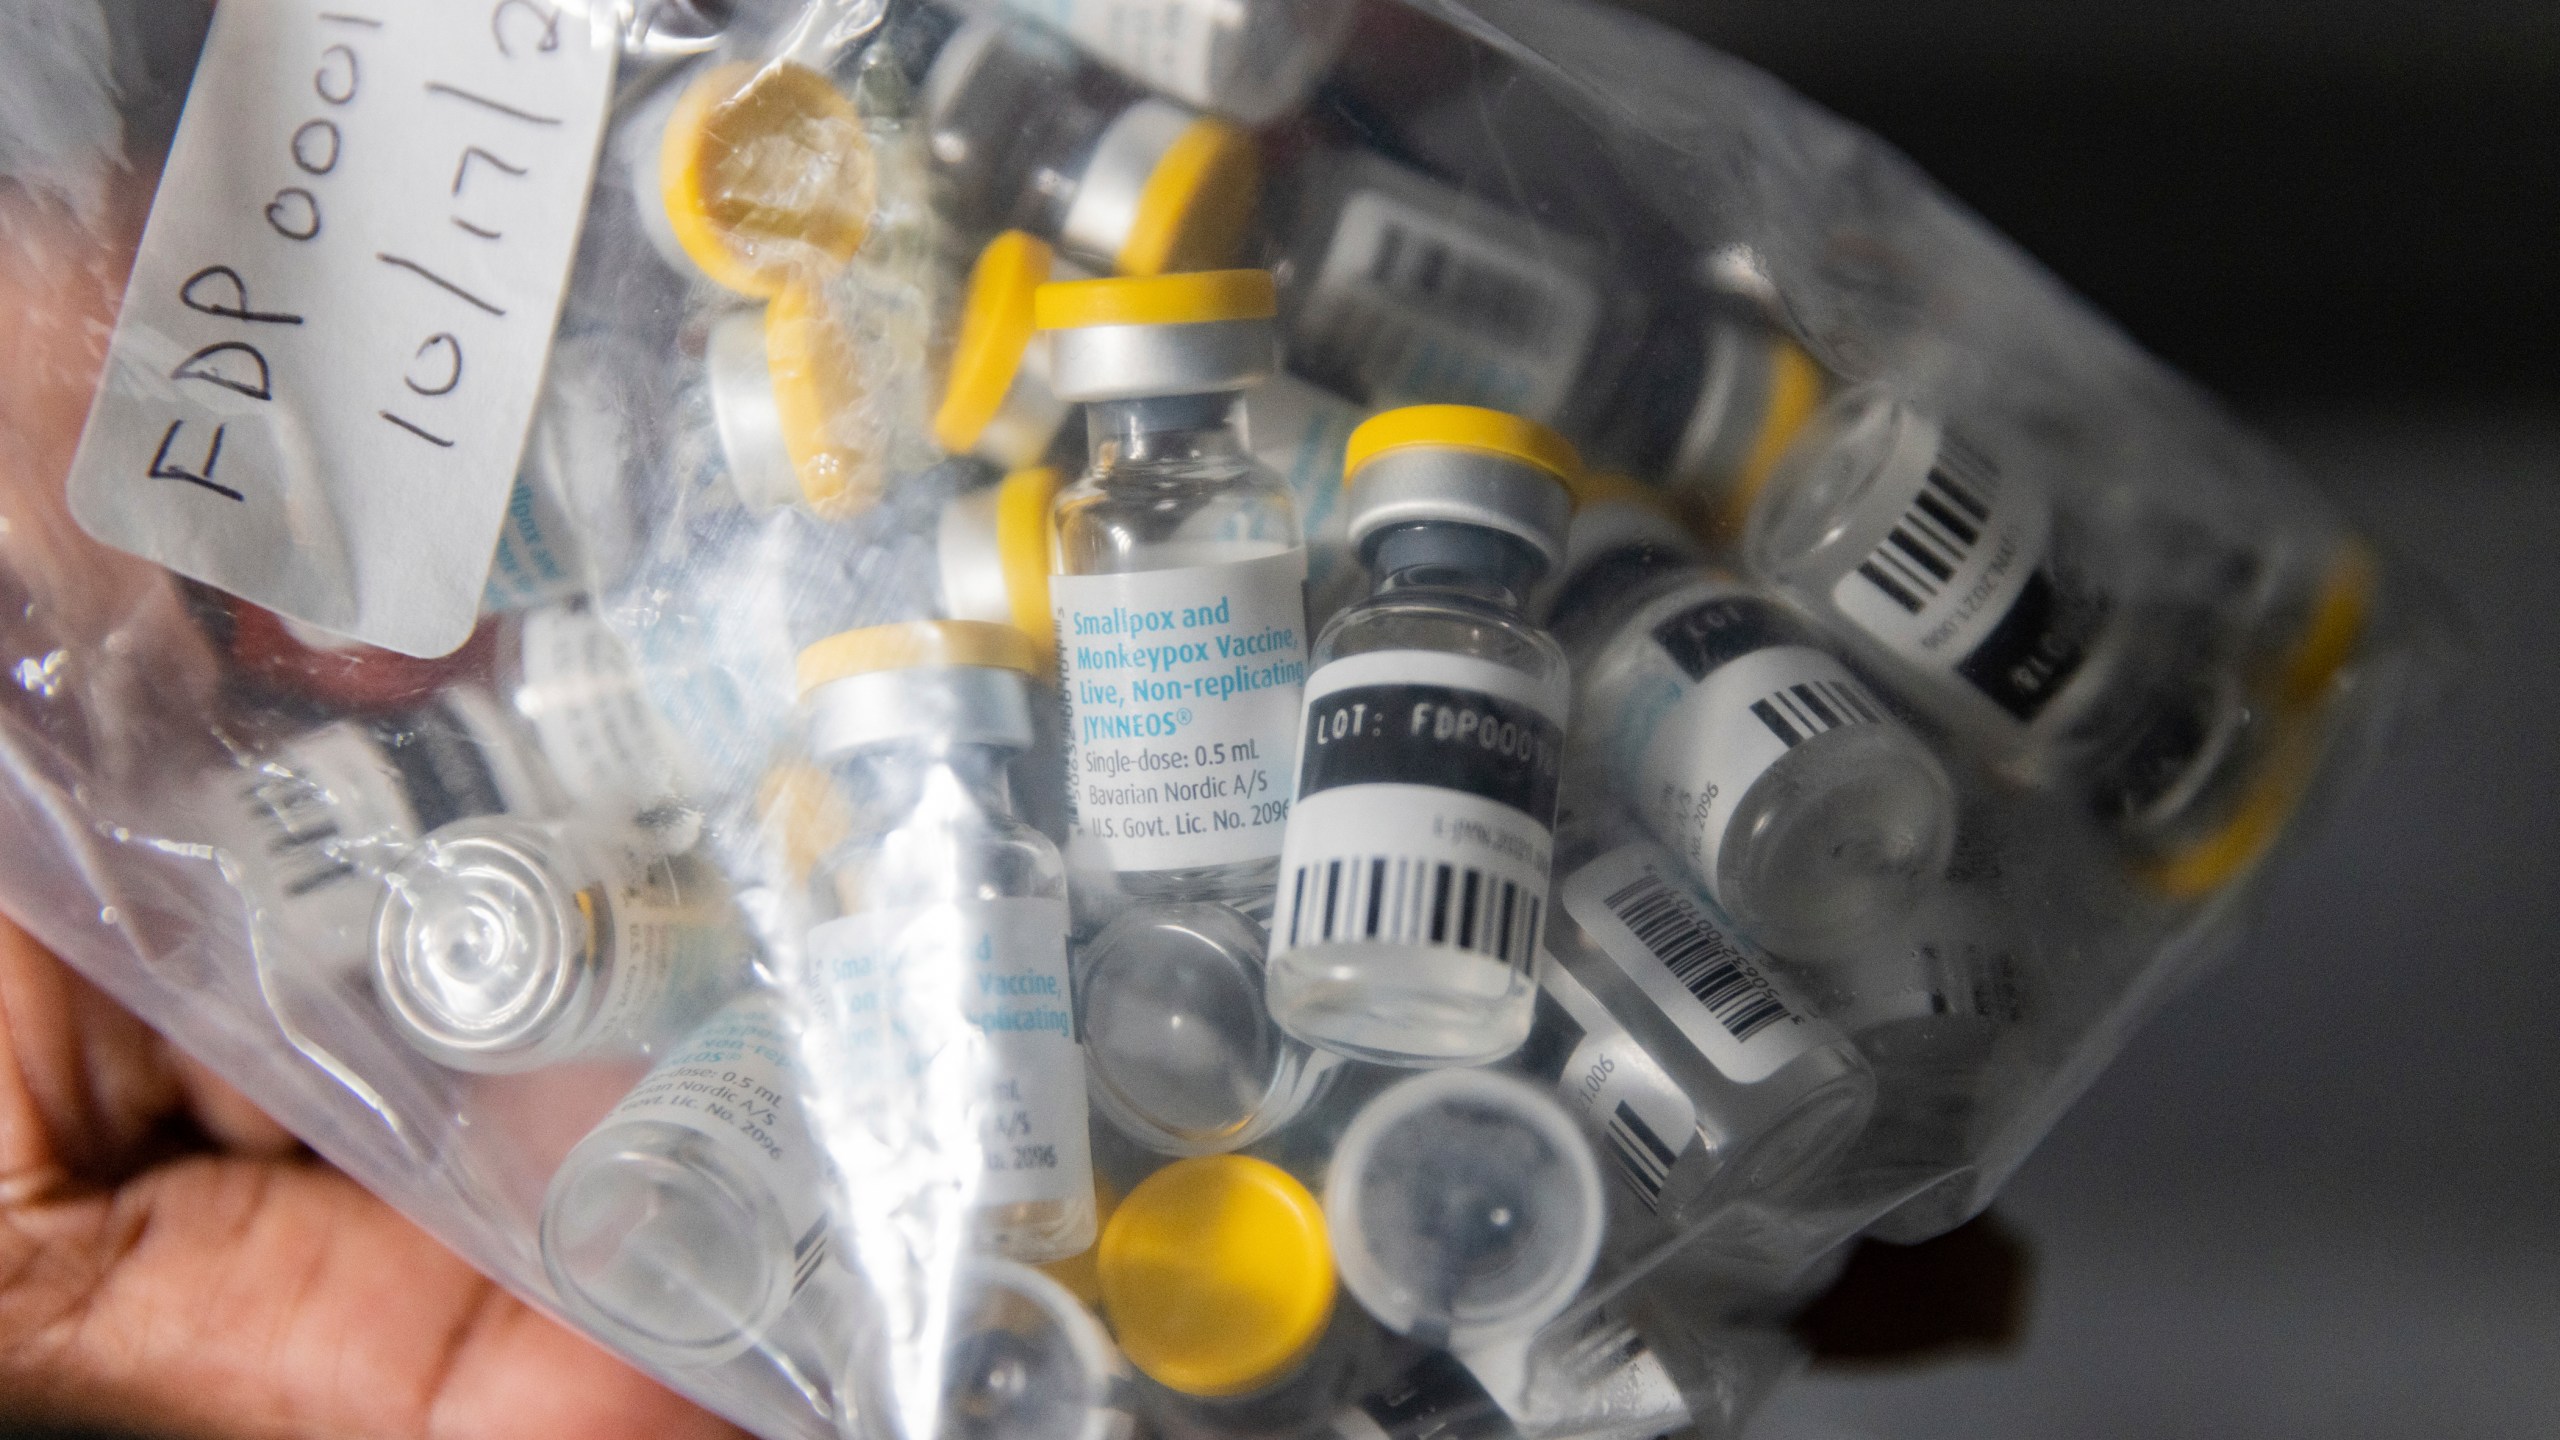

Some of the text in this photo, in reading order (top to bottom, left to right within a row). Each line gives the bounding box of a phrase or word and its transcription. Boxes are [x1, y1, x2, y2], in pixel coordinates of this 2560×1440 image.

[148, 265, 304, 502] FDP
[1073, 596, 1230, 639] Smallpox and
[1077, 627, 1298, 672] Monkeypox Vaccine,
[1080, 660, 1305, 708] Live, Non-replicating
[1317, 704, 1384, 746] LOT:
[1086, 738, 1259, 778] Single-dose: 0.5 mL
[1088, 769, 1268, 805] Bavarian Nordic A/S
[1694, 782, 1719, 831] 2096
[1091, 817, 1119, 839] U.S.
[1123, 814, 1171, 838] Govt.
[1176, 811, 1207, 835] Lic.
[1213, 807, 1246, 830] No.
[722, 1070, 754, 1089] 0.5
[680, 1079, 739, 1103] Nordic
[739, 1099, 778, 1128] A/S
[741, 1119, 786, 1161] 2096
